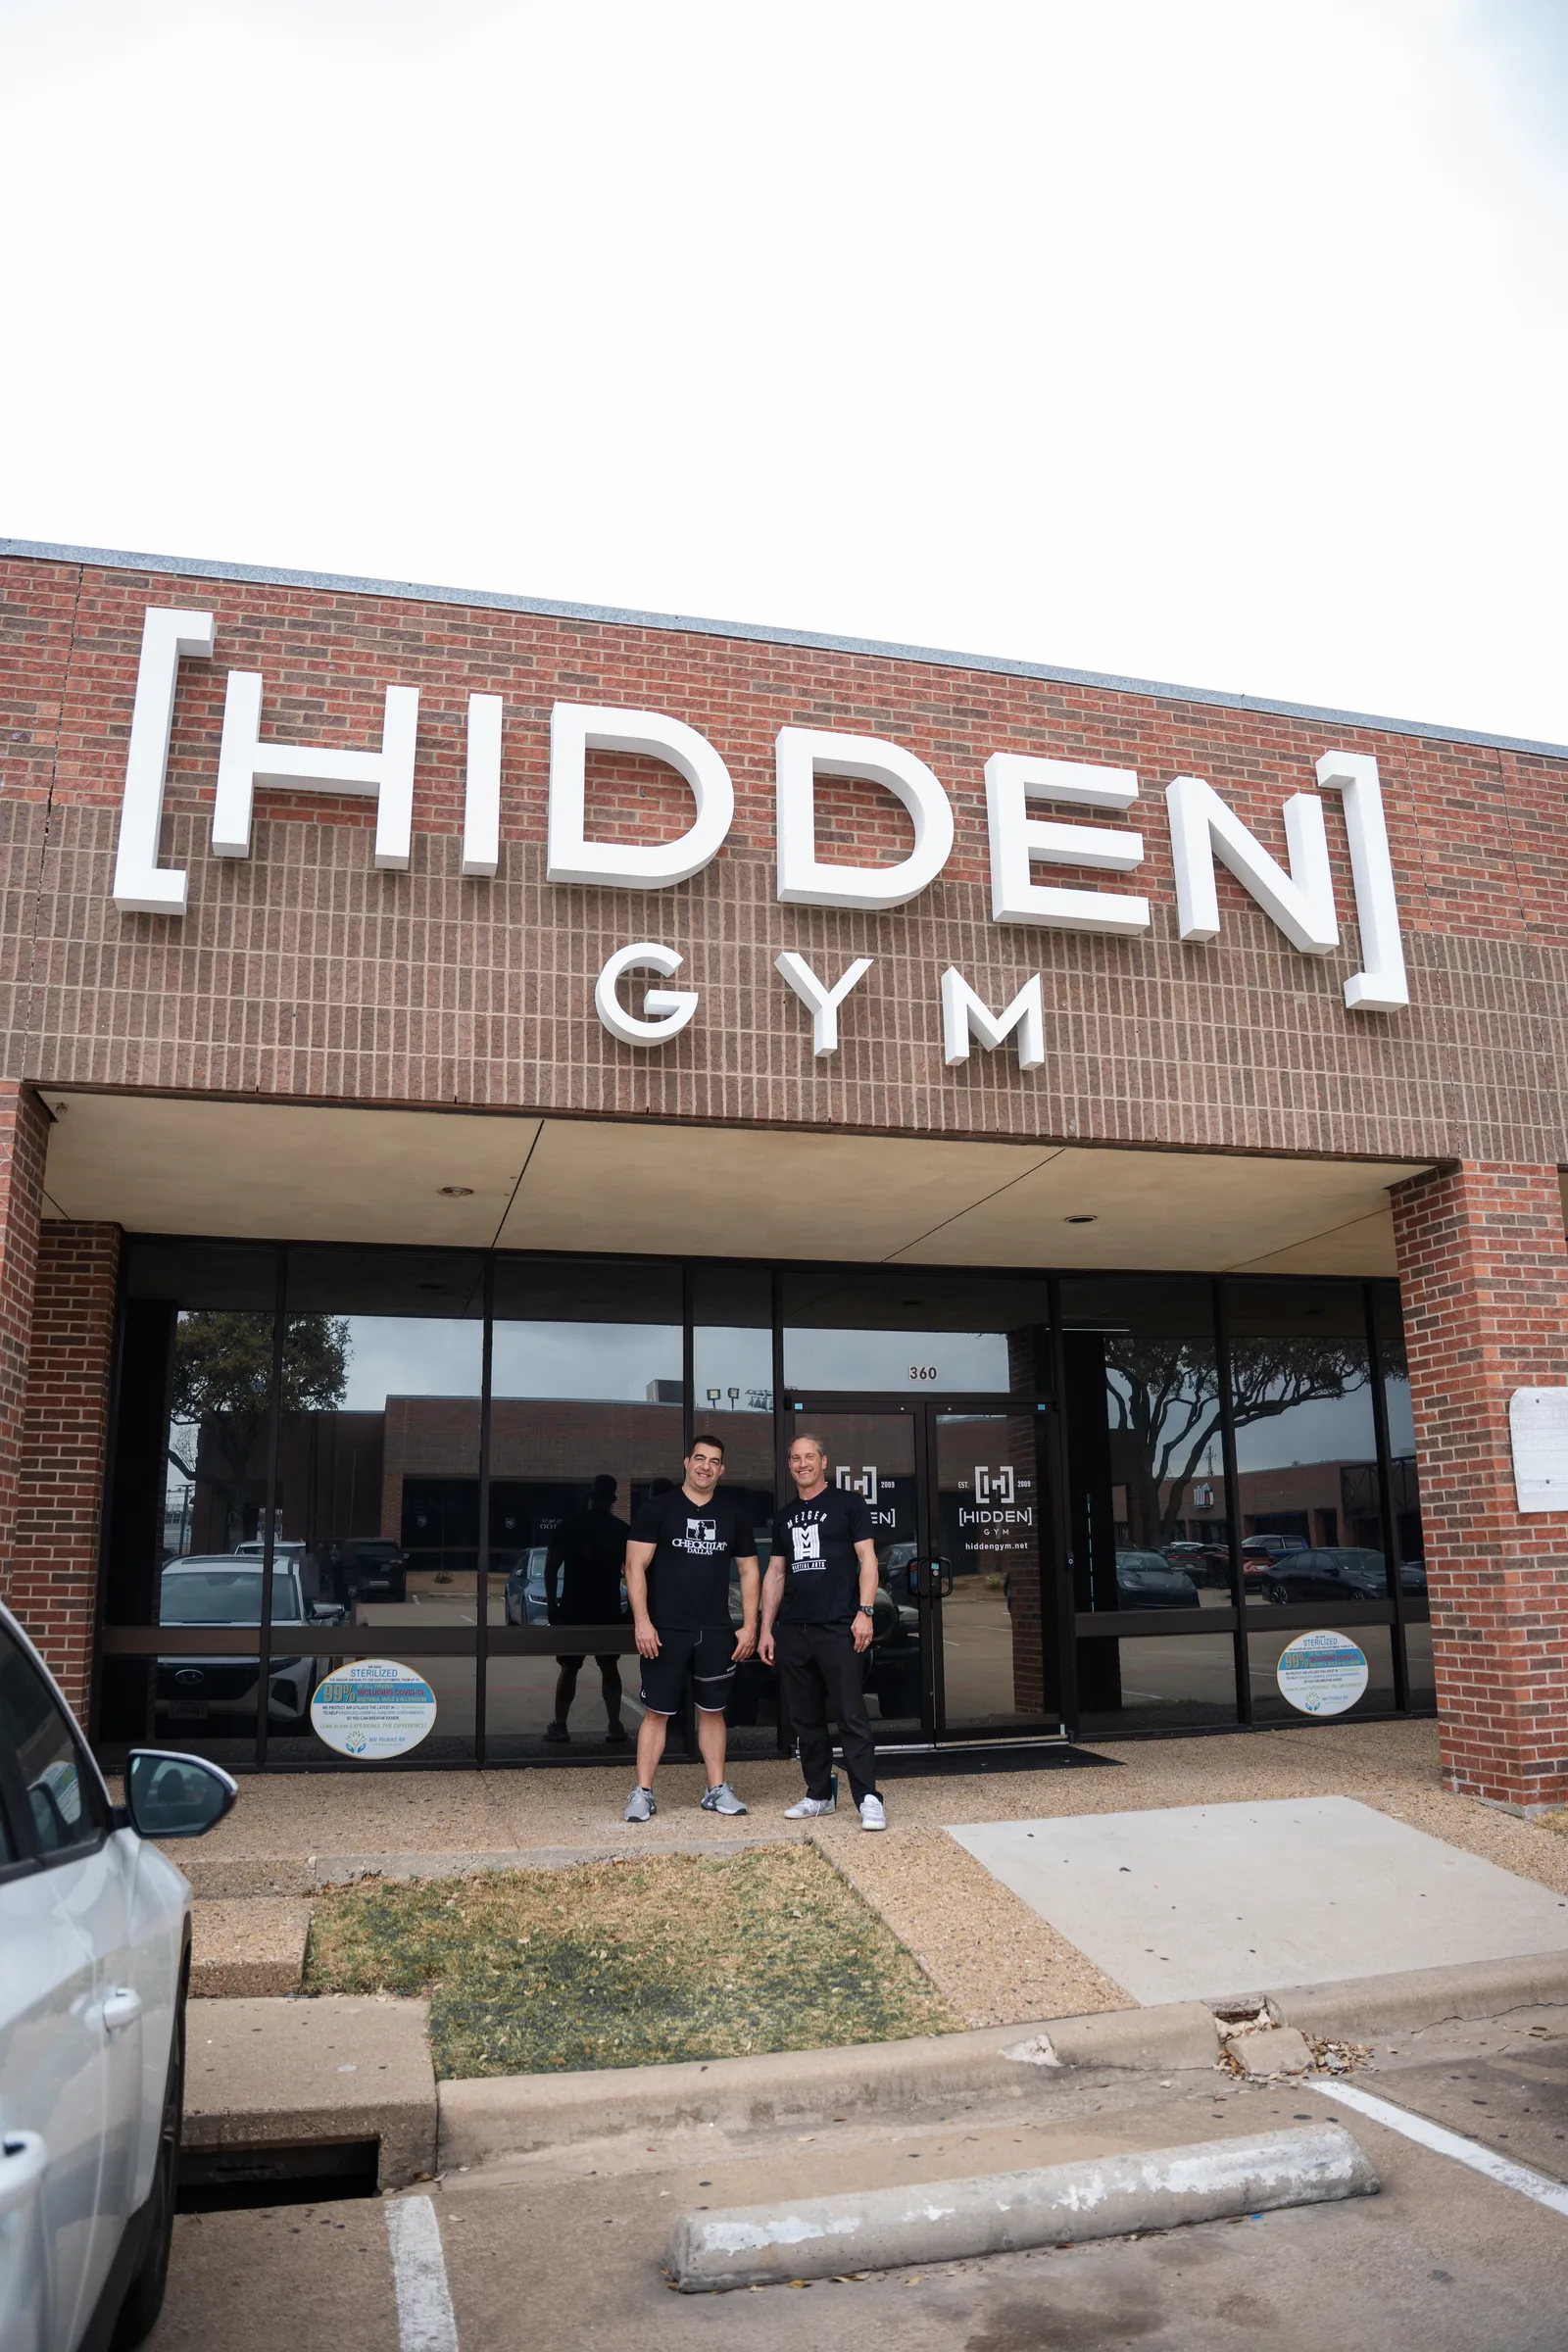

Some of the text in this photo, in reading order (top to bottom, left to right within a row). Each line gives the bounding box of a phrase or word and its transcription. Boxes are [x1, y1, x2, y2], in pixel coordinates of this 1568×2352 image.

[113, 607, 1408, 1013] [HIDDEN]
[595, 942, 1046, 1070] GYM
[909, 1366, 938, 1380] 360
[787, 1510, 828, 1529] MEZGER
[958, 1507, 1033, 1527] [HIDDEN]
[671, 1538, 728, 1551] CHECKMAT
[965, 1543, 1028, 1551] hiddengym.net
[1303, 1638, 1338, 1647] STERILIZED
[1285, 1652, 1308, 1668] 99%
[350, 1669, 398, 1677] STERILIZED
[324, 1684, 355, 1702] 99%
